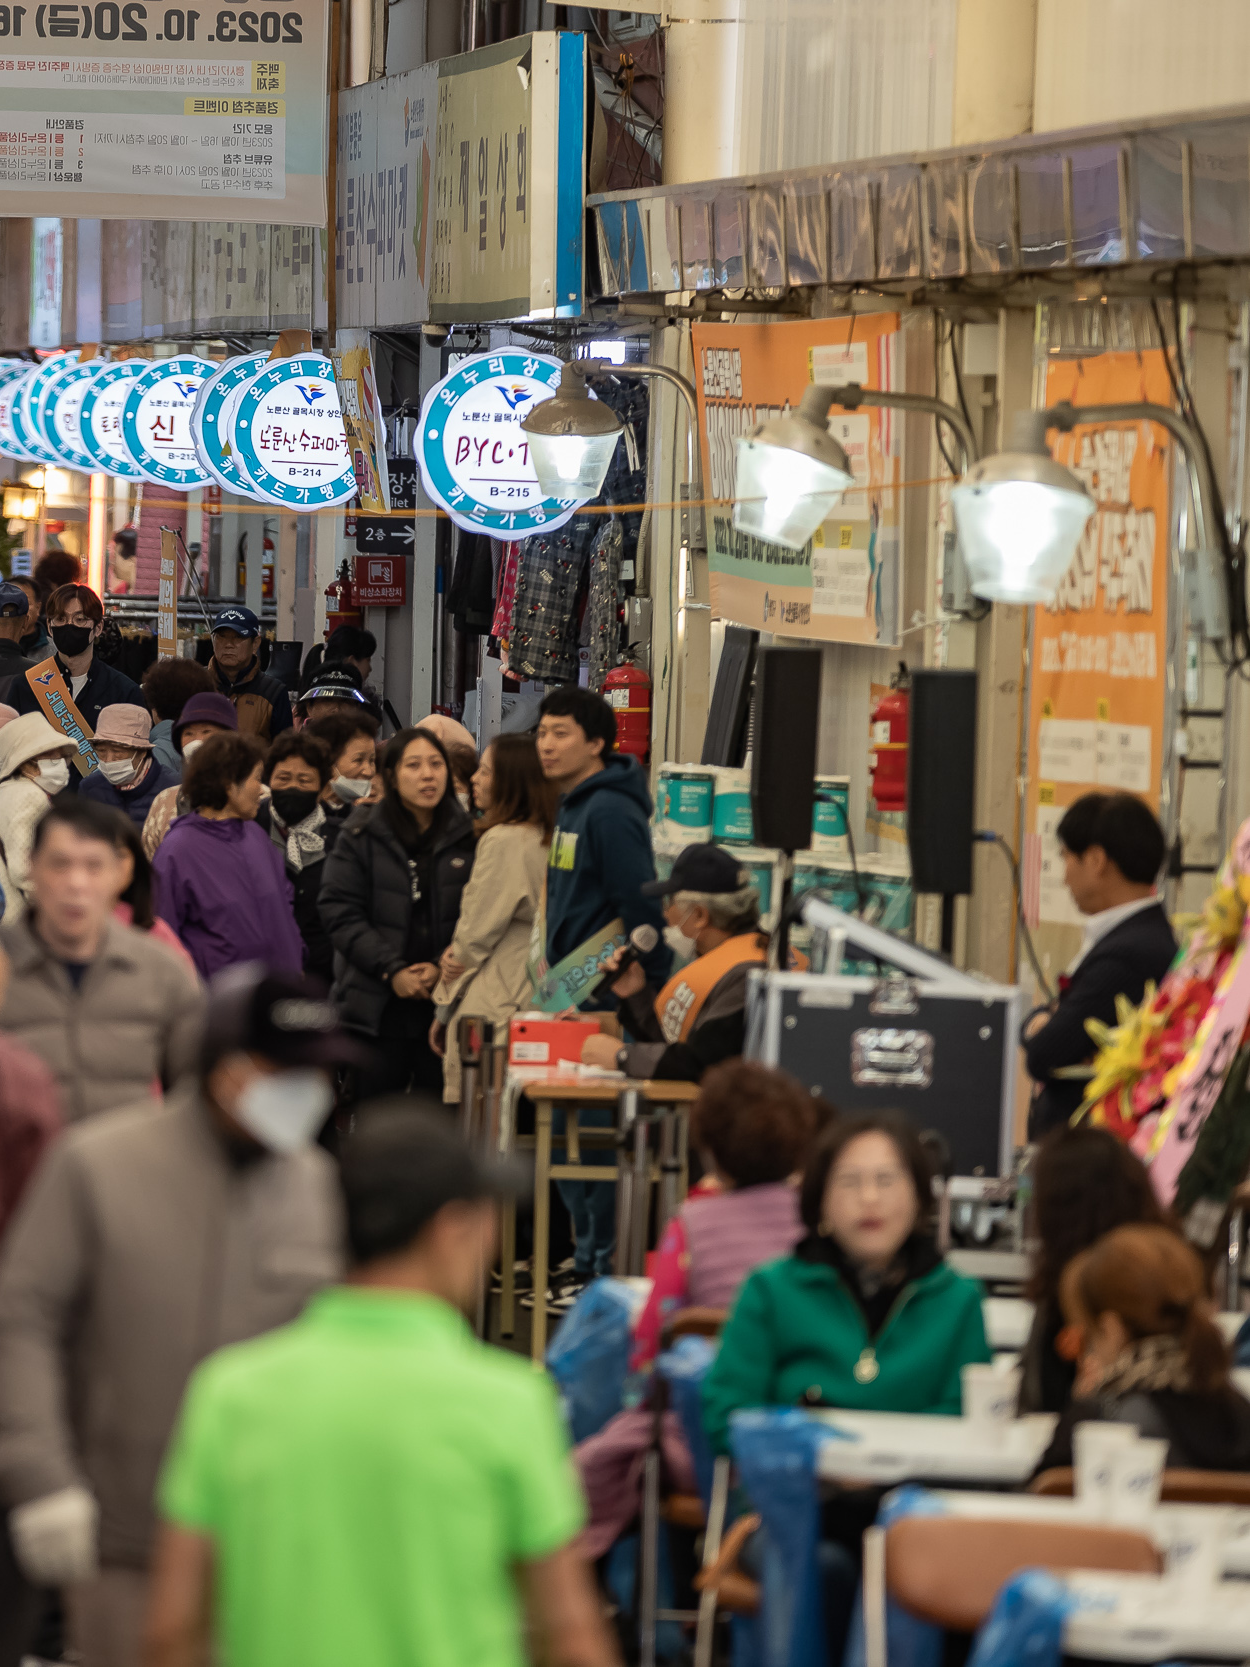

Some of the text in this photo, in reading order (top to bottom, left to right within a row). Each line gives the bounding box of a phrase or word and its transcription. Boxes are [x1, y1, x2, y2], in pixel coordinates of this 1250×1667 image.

[267, 406, 290, 415] 노룬산
[292, 407, 324, 417] 골목시장
[462, 412, 490, 422] 노룬산
[150, 415, 175, 442] 신
[288, 467, 322, 477] B-214
[254, 466, 357, 503] 카드가맹점
[490, 487, 530, 498] B-215
[365, 527, 386, 541] 2층
[360, 587, 402, 598] 비상소화장치
[45, 691, 100, 773] 노룬산골목시
